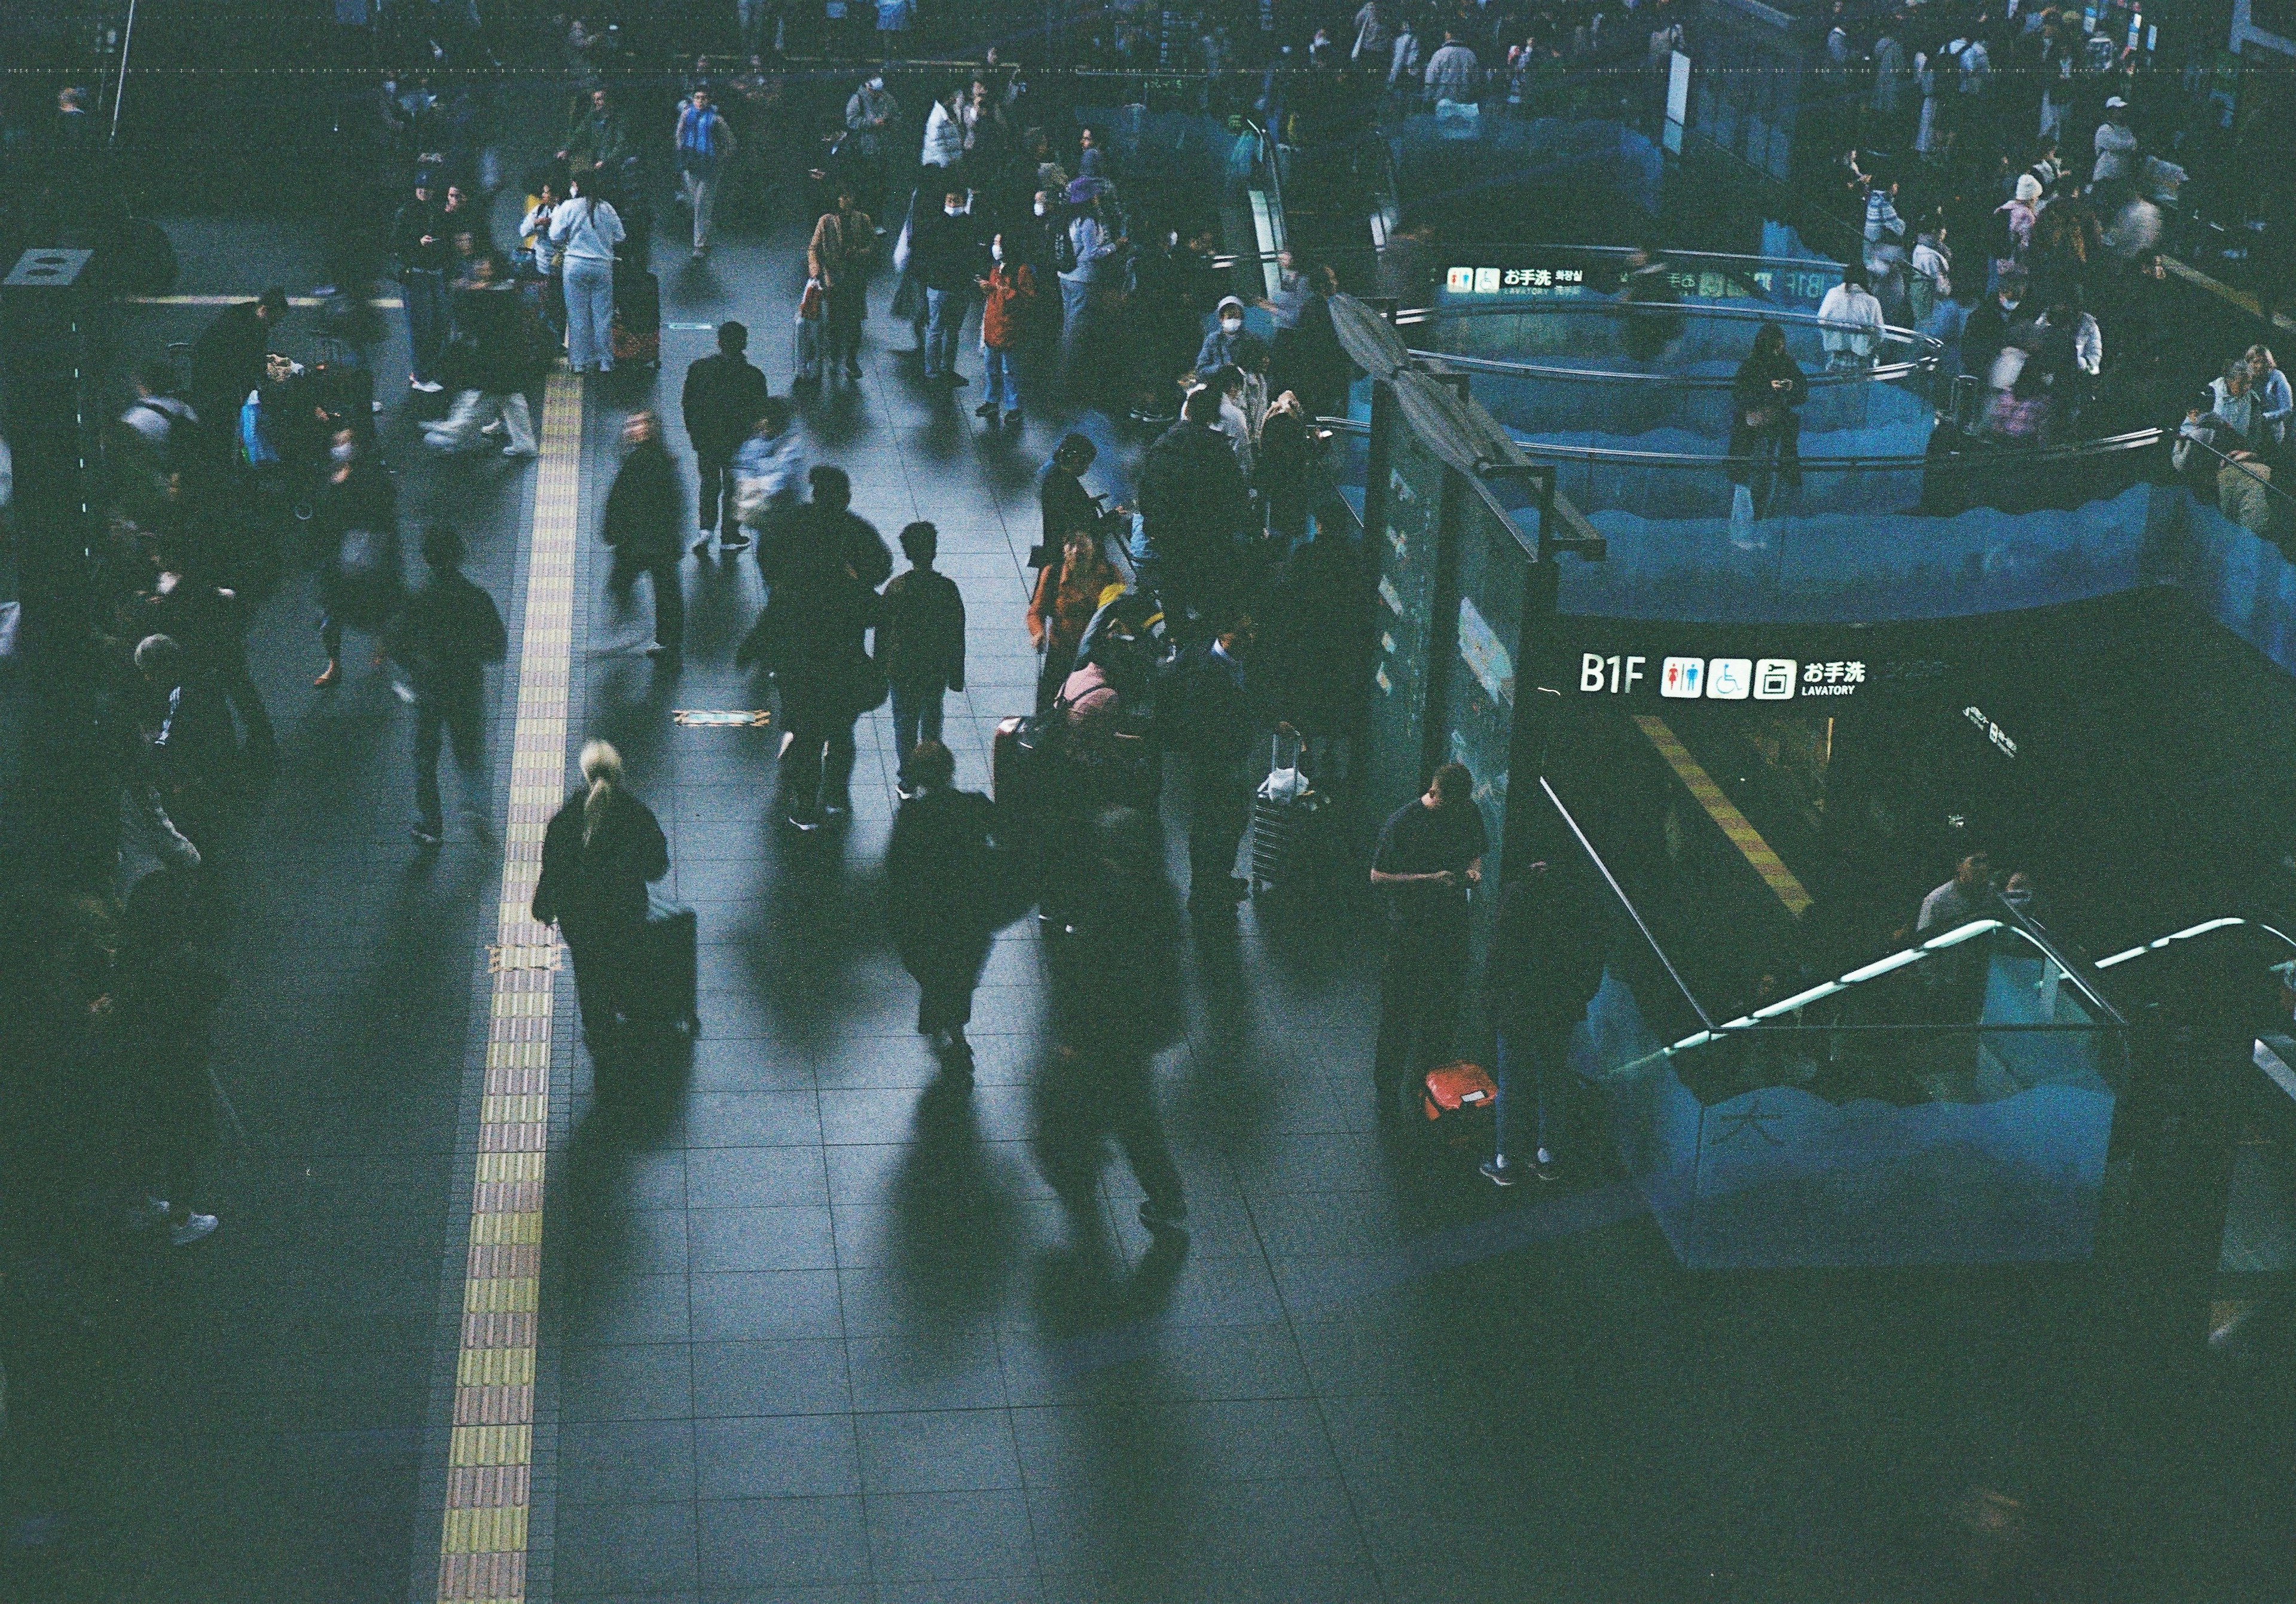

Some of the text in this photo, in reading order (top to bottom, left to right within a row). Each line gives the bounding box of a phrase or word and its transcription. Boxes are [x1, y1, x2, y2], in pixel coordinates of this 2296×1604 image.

[1504, 269, 1552, 286] お手洗
[1555, 270, 1583, 282] 화장실
[1580, 653, 1646, 694] B1F
[1804, 661, 1866, 683] お手洗
[1802, 685, 1855, 696] LAVATORY
